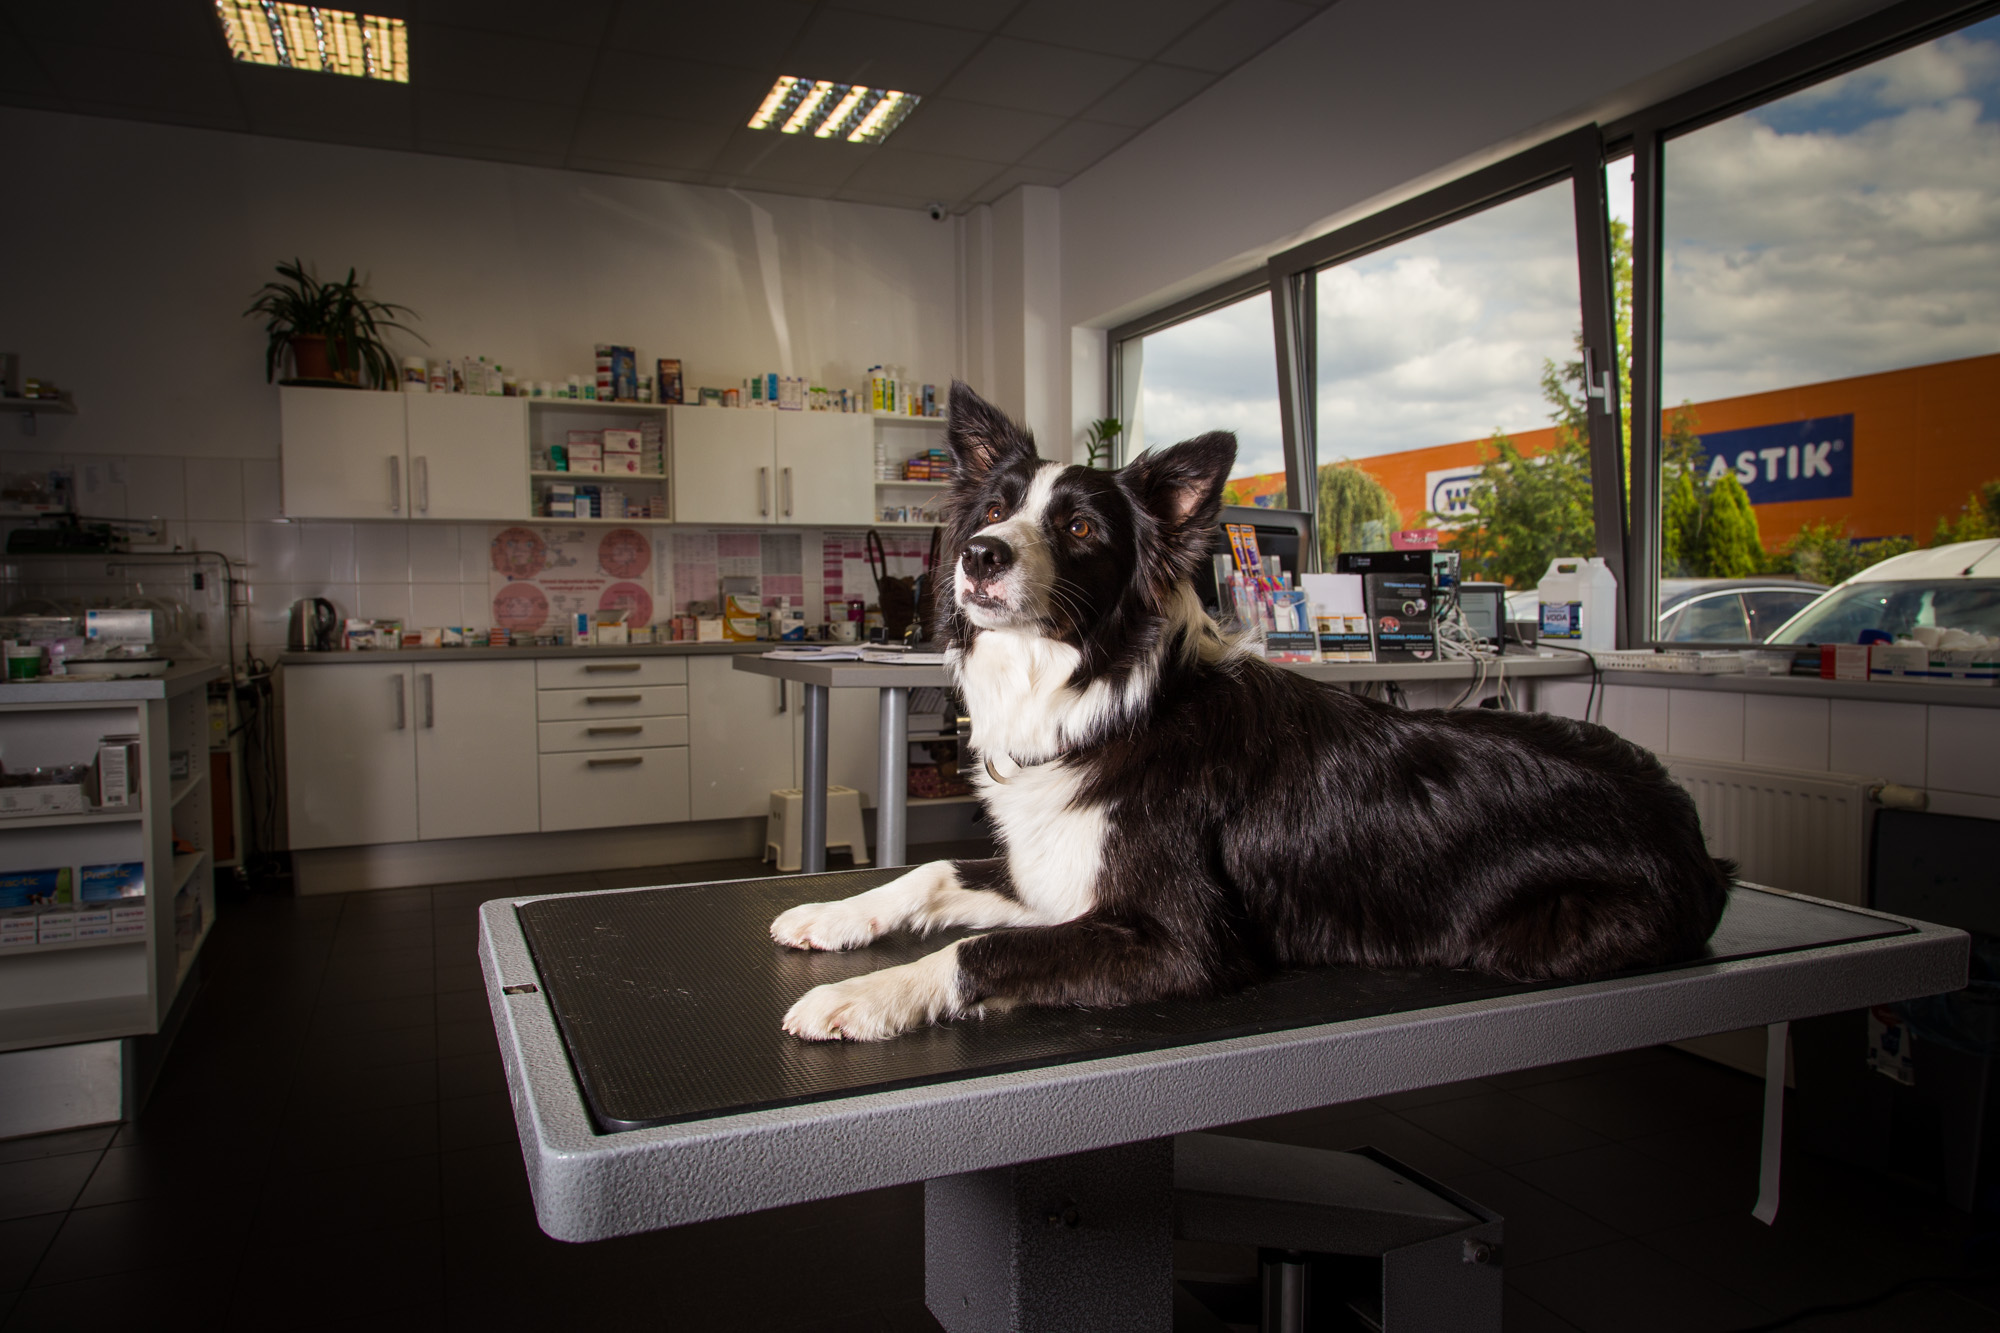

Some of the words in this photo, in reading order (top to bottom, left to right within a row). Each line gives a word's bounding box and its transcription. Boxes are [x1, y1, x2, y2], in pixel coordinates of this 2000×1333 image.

[1664, 440, 1833, 487] ASTIK
[1545, 613, 1568, 621] VODA
[0, 877, 39, 887] rac-tic
